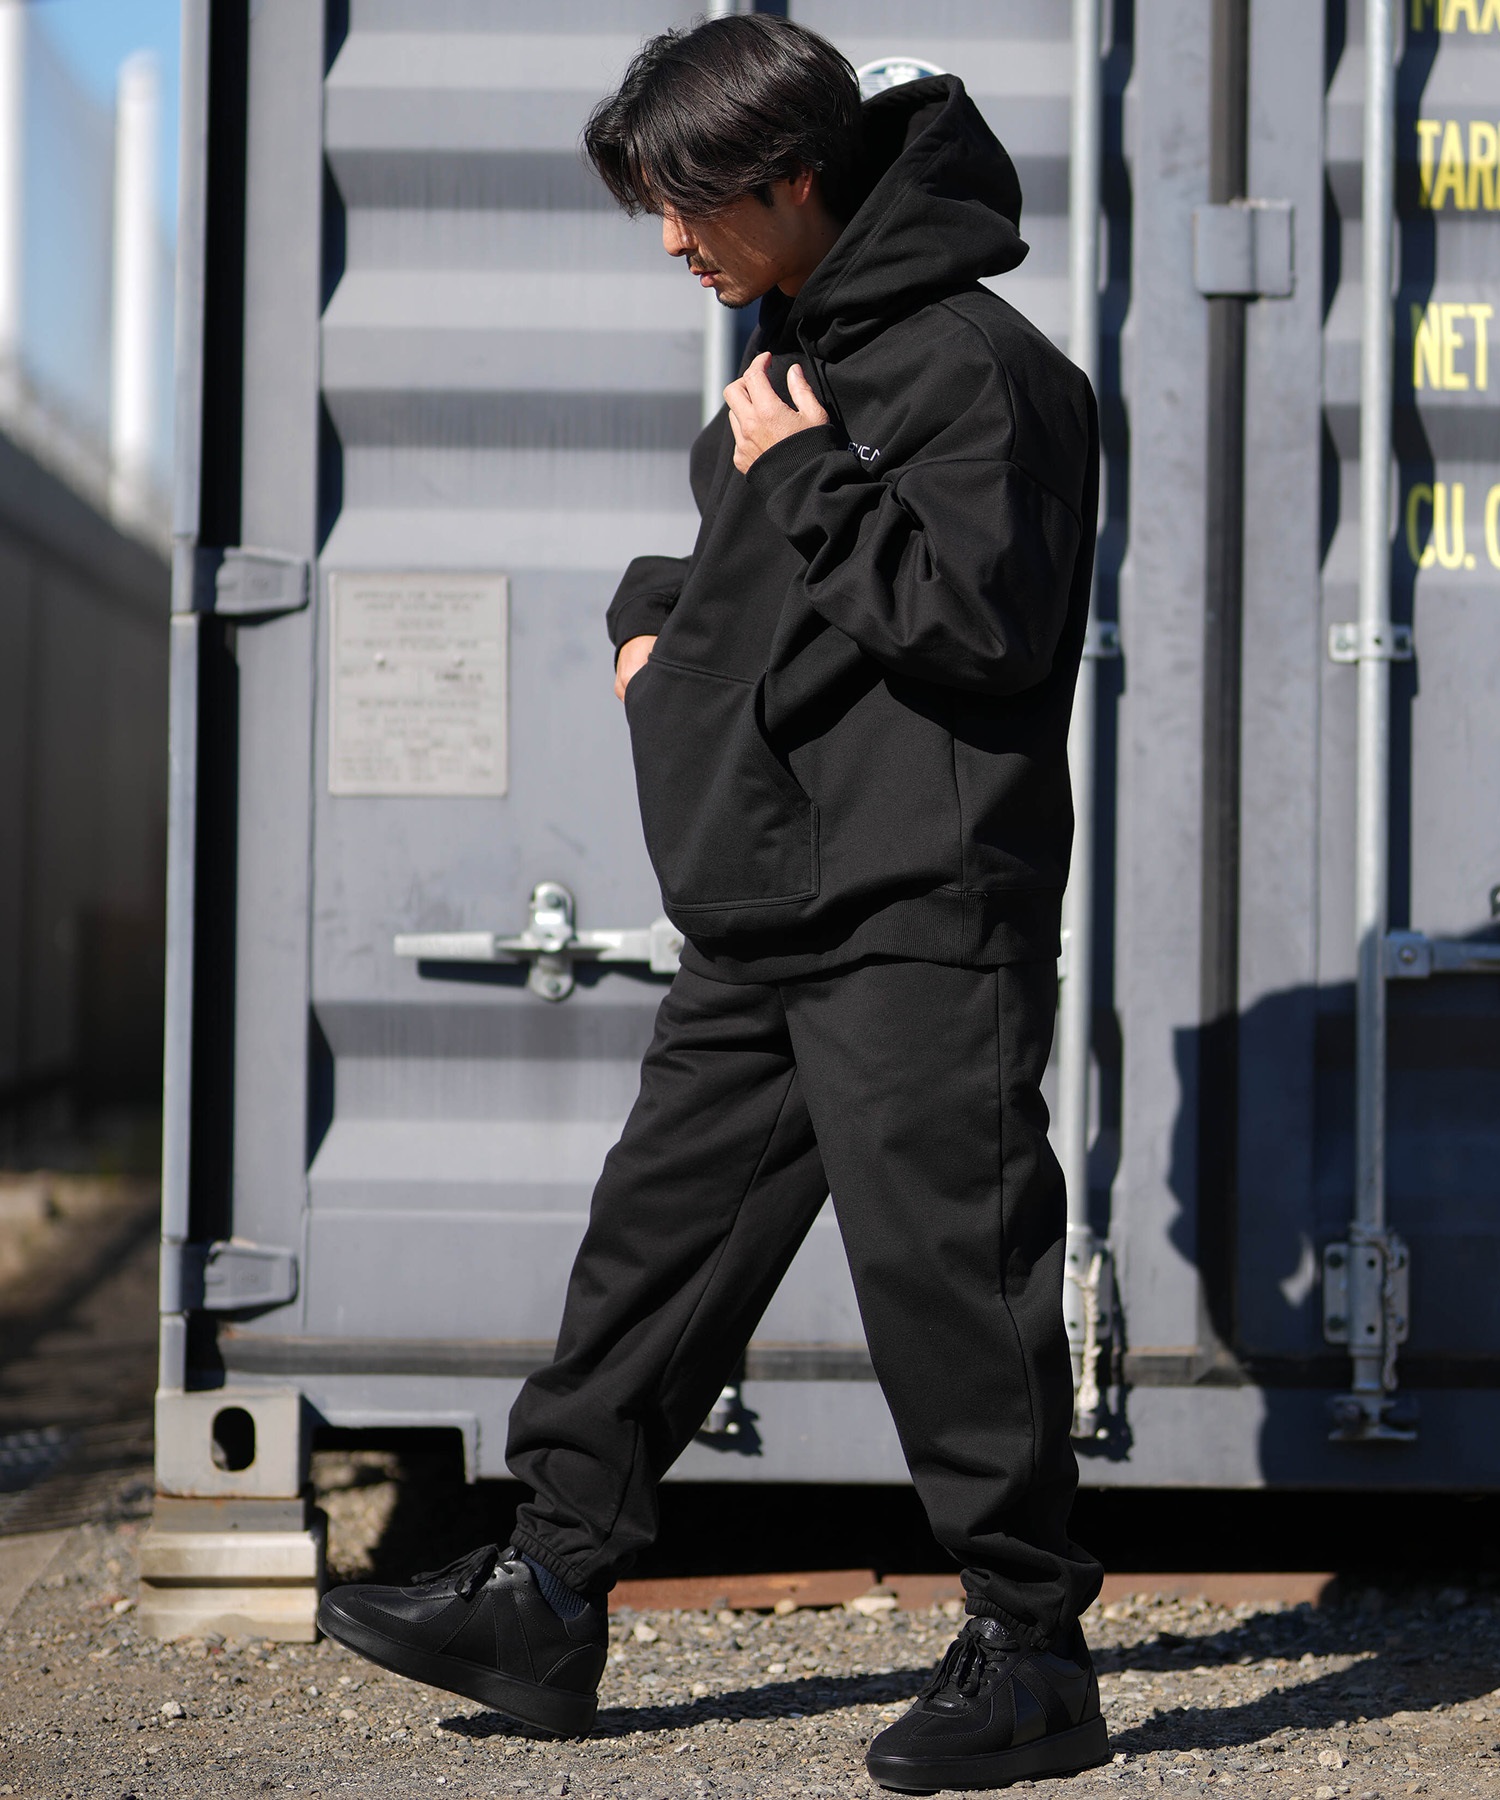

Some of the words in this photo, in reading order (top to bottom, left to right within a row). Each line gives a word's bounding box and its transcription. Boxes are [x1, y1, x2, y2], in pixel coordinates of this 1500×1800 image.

[1416, 119, 1500, 211] TAR
[1411, 303, 1493, 391] NET
[1406, 482, 1476, 570] CU.
